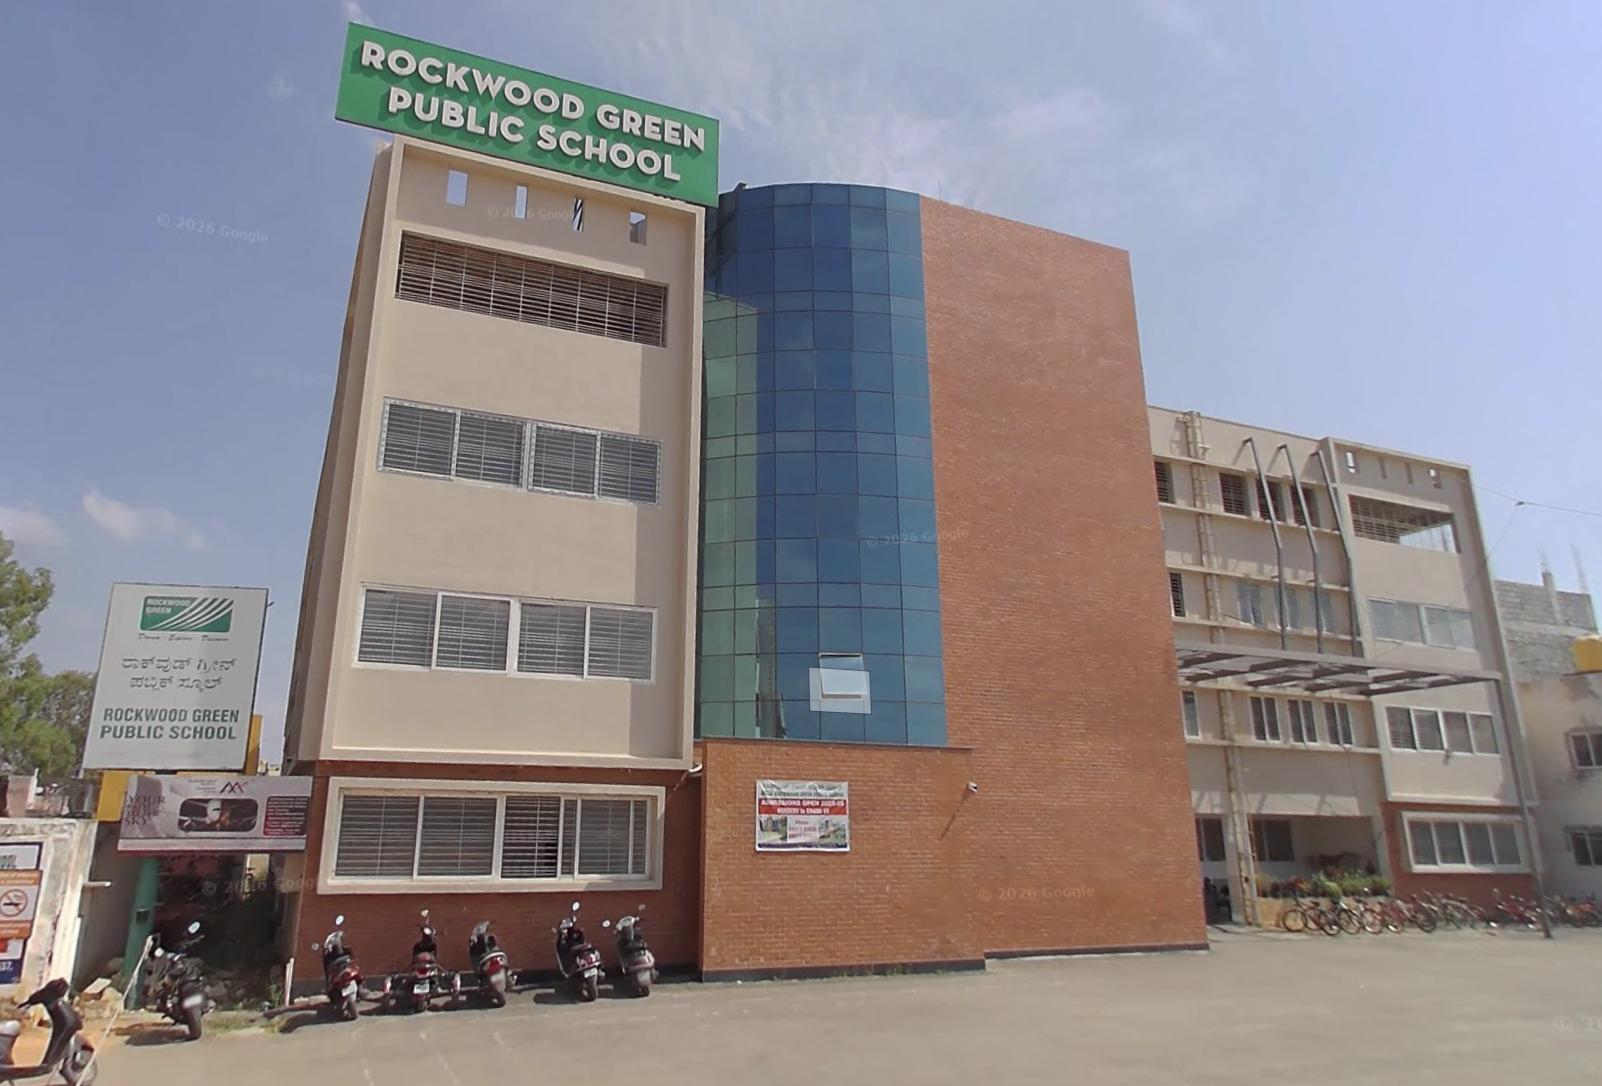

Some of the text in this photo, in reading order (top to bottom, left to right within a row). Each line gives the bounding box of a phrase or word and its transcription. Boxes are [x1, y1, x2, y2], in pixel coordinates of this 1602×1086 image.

[361, 40, 705, 152] ROCKWOOD GREEN
[388, 86, 681, 182] PUBLIC SCHOOL
[103, 708, 240, 722] ROCKWOOD GREEN
[100, 725, 237, 740] PUBLIC SCHOOL
[124, 817, 149, 825] SKY
